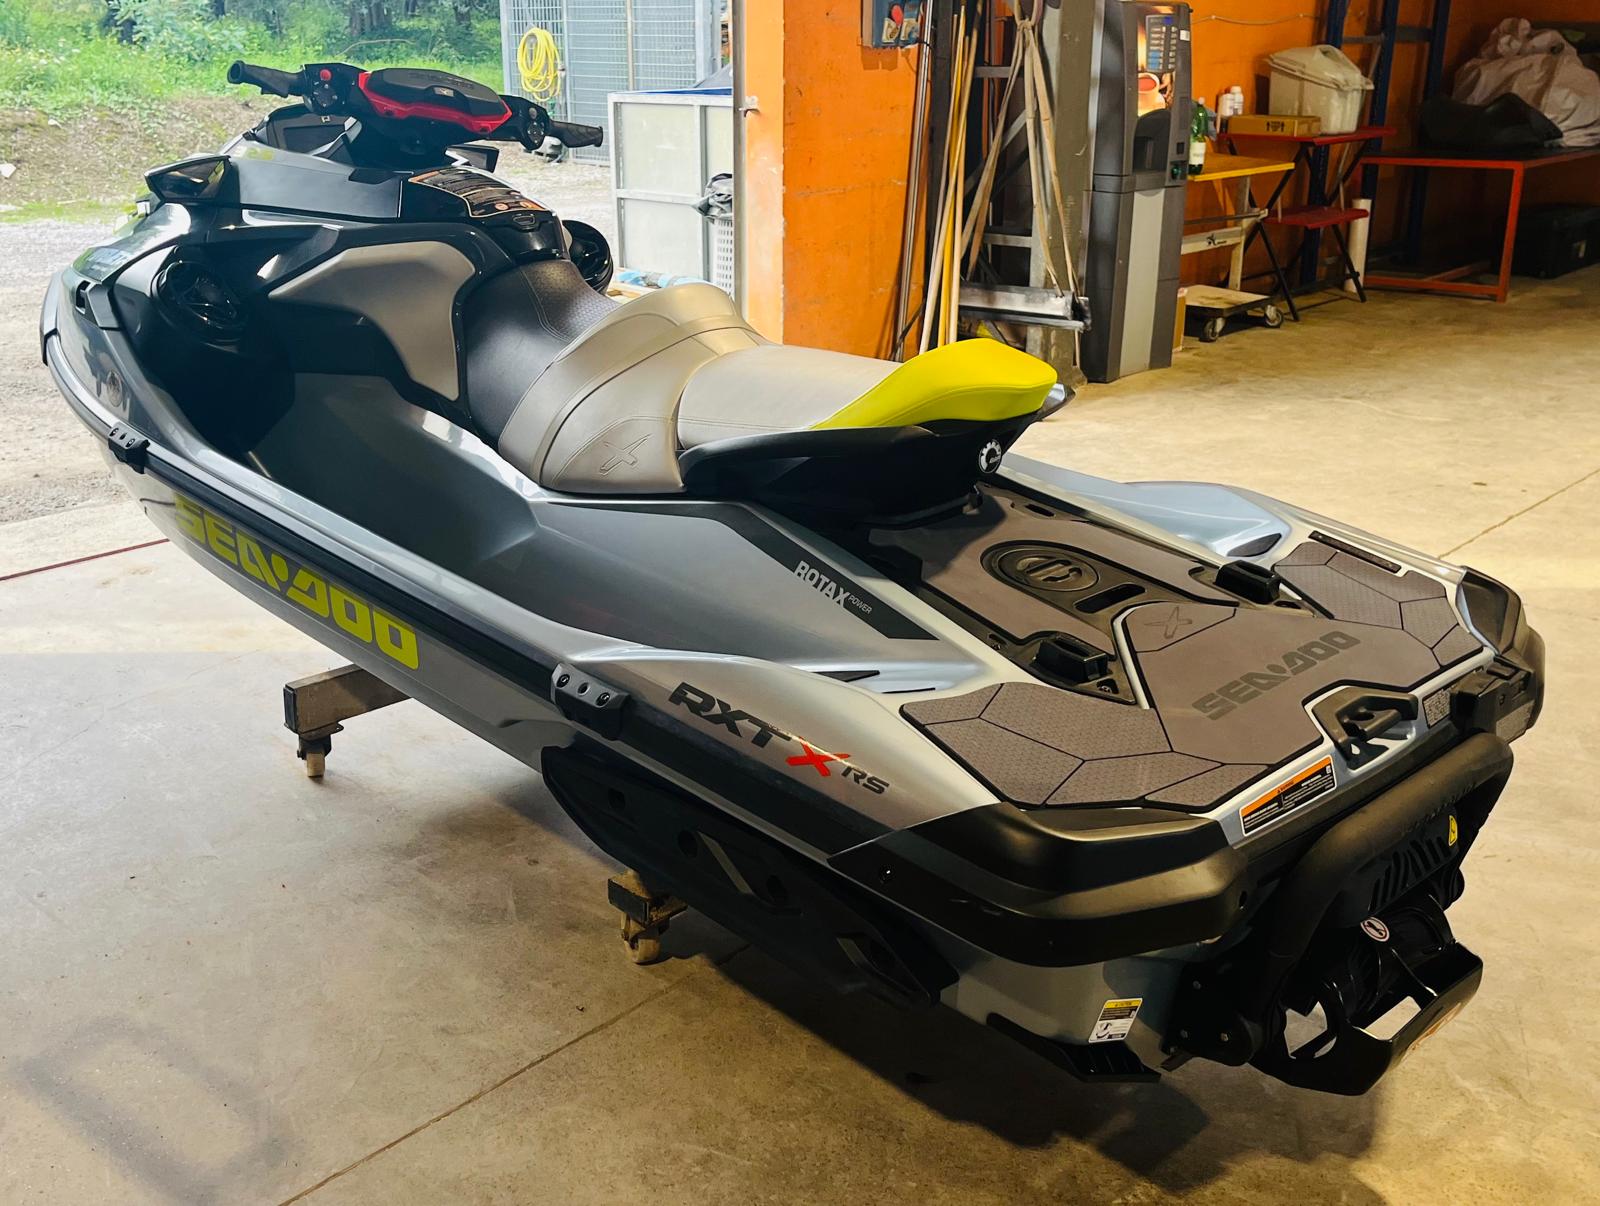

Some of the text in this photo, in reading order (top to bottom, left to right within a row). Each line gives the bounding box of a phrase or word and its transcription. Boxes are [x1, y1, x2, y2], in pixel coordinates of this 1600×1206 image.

[794, 560, 873, 615] ROTAX POWER
[668, 681, 890, 795] RXT X RS
